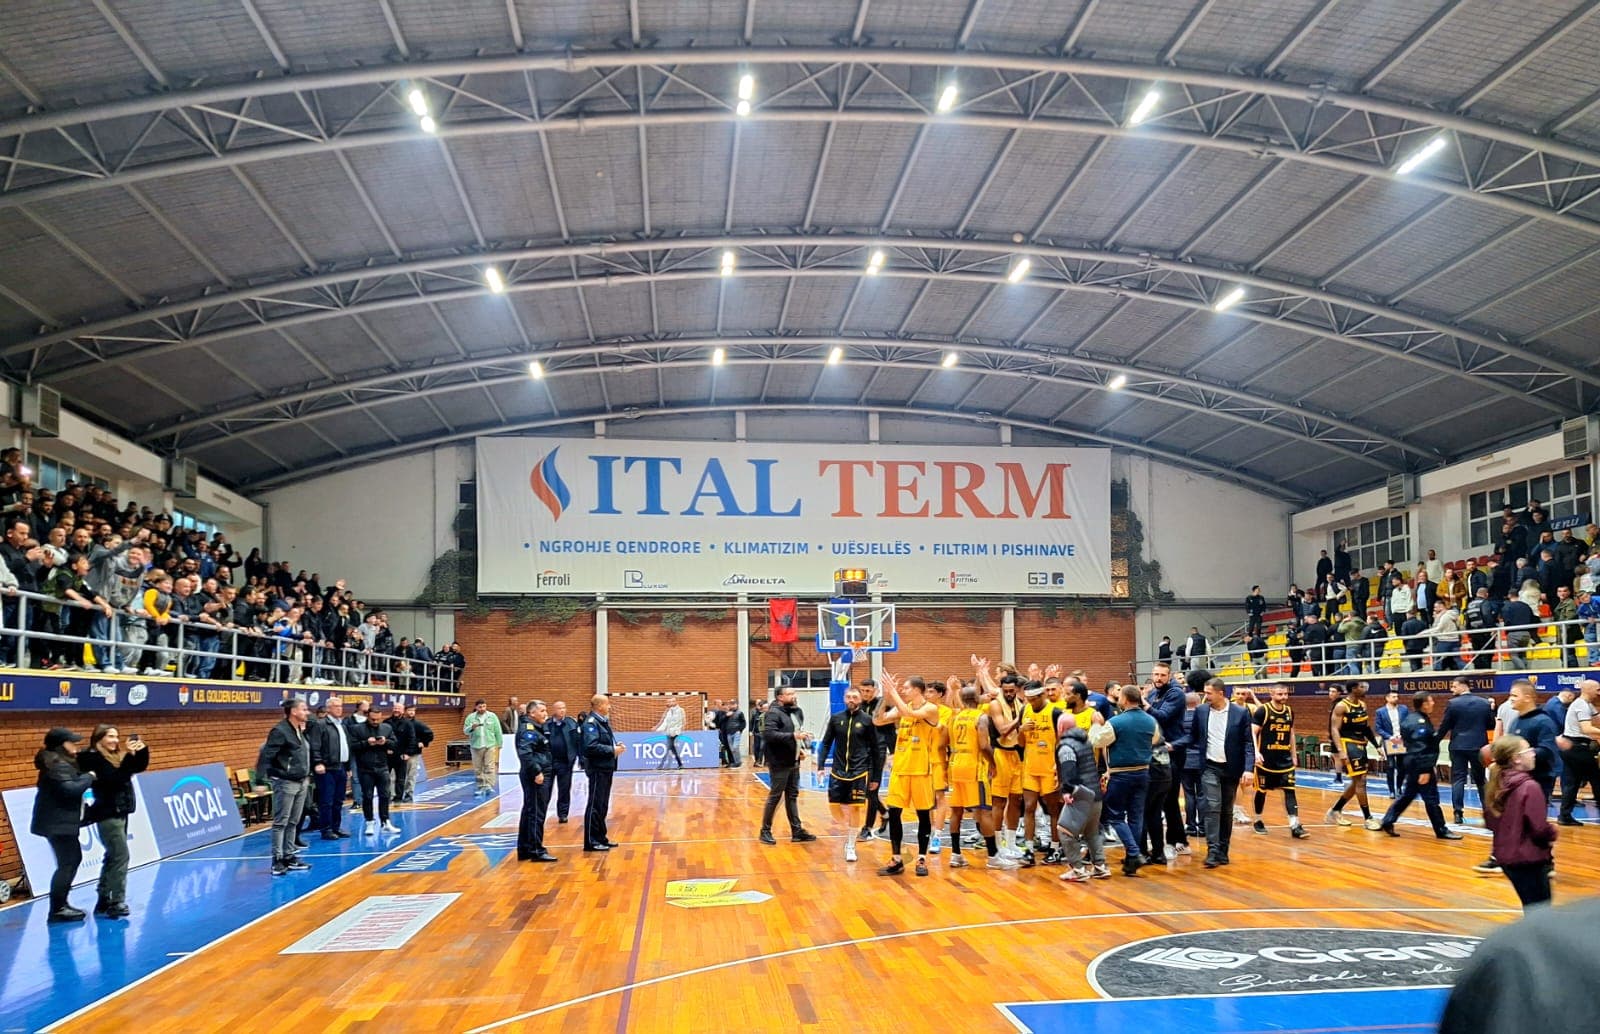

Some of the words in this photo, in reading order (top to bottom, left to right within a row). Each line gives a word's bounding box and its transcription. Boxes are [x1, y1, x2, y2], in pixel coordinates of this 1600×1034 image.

[588, 455, 801, 517] ITAL
[819, 460, 1072, 519] TERM
[539, 540, 612, 553] NGROHJE
[616, 541, 701, 554] QENDRORE
[724, 541, 809, 555] KLIMATIZIM
[832, 540, 912, 555] UJËSJELLËS
[933, 543, 989, 556] FILTRIM
[1001, 544, 1075, 557] PISHINAVE
[536, 573, 571, 588] Ferroli
[1028, 572, 1048, 585] G3
[1418, 681, 1447, 690] GOLDEN
[1475, 679, 1493, 689] YLLI
[632, 741, 703, 760] TROAL
[163, 788, 228, 829] TROCAL
